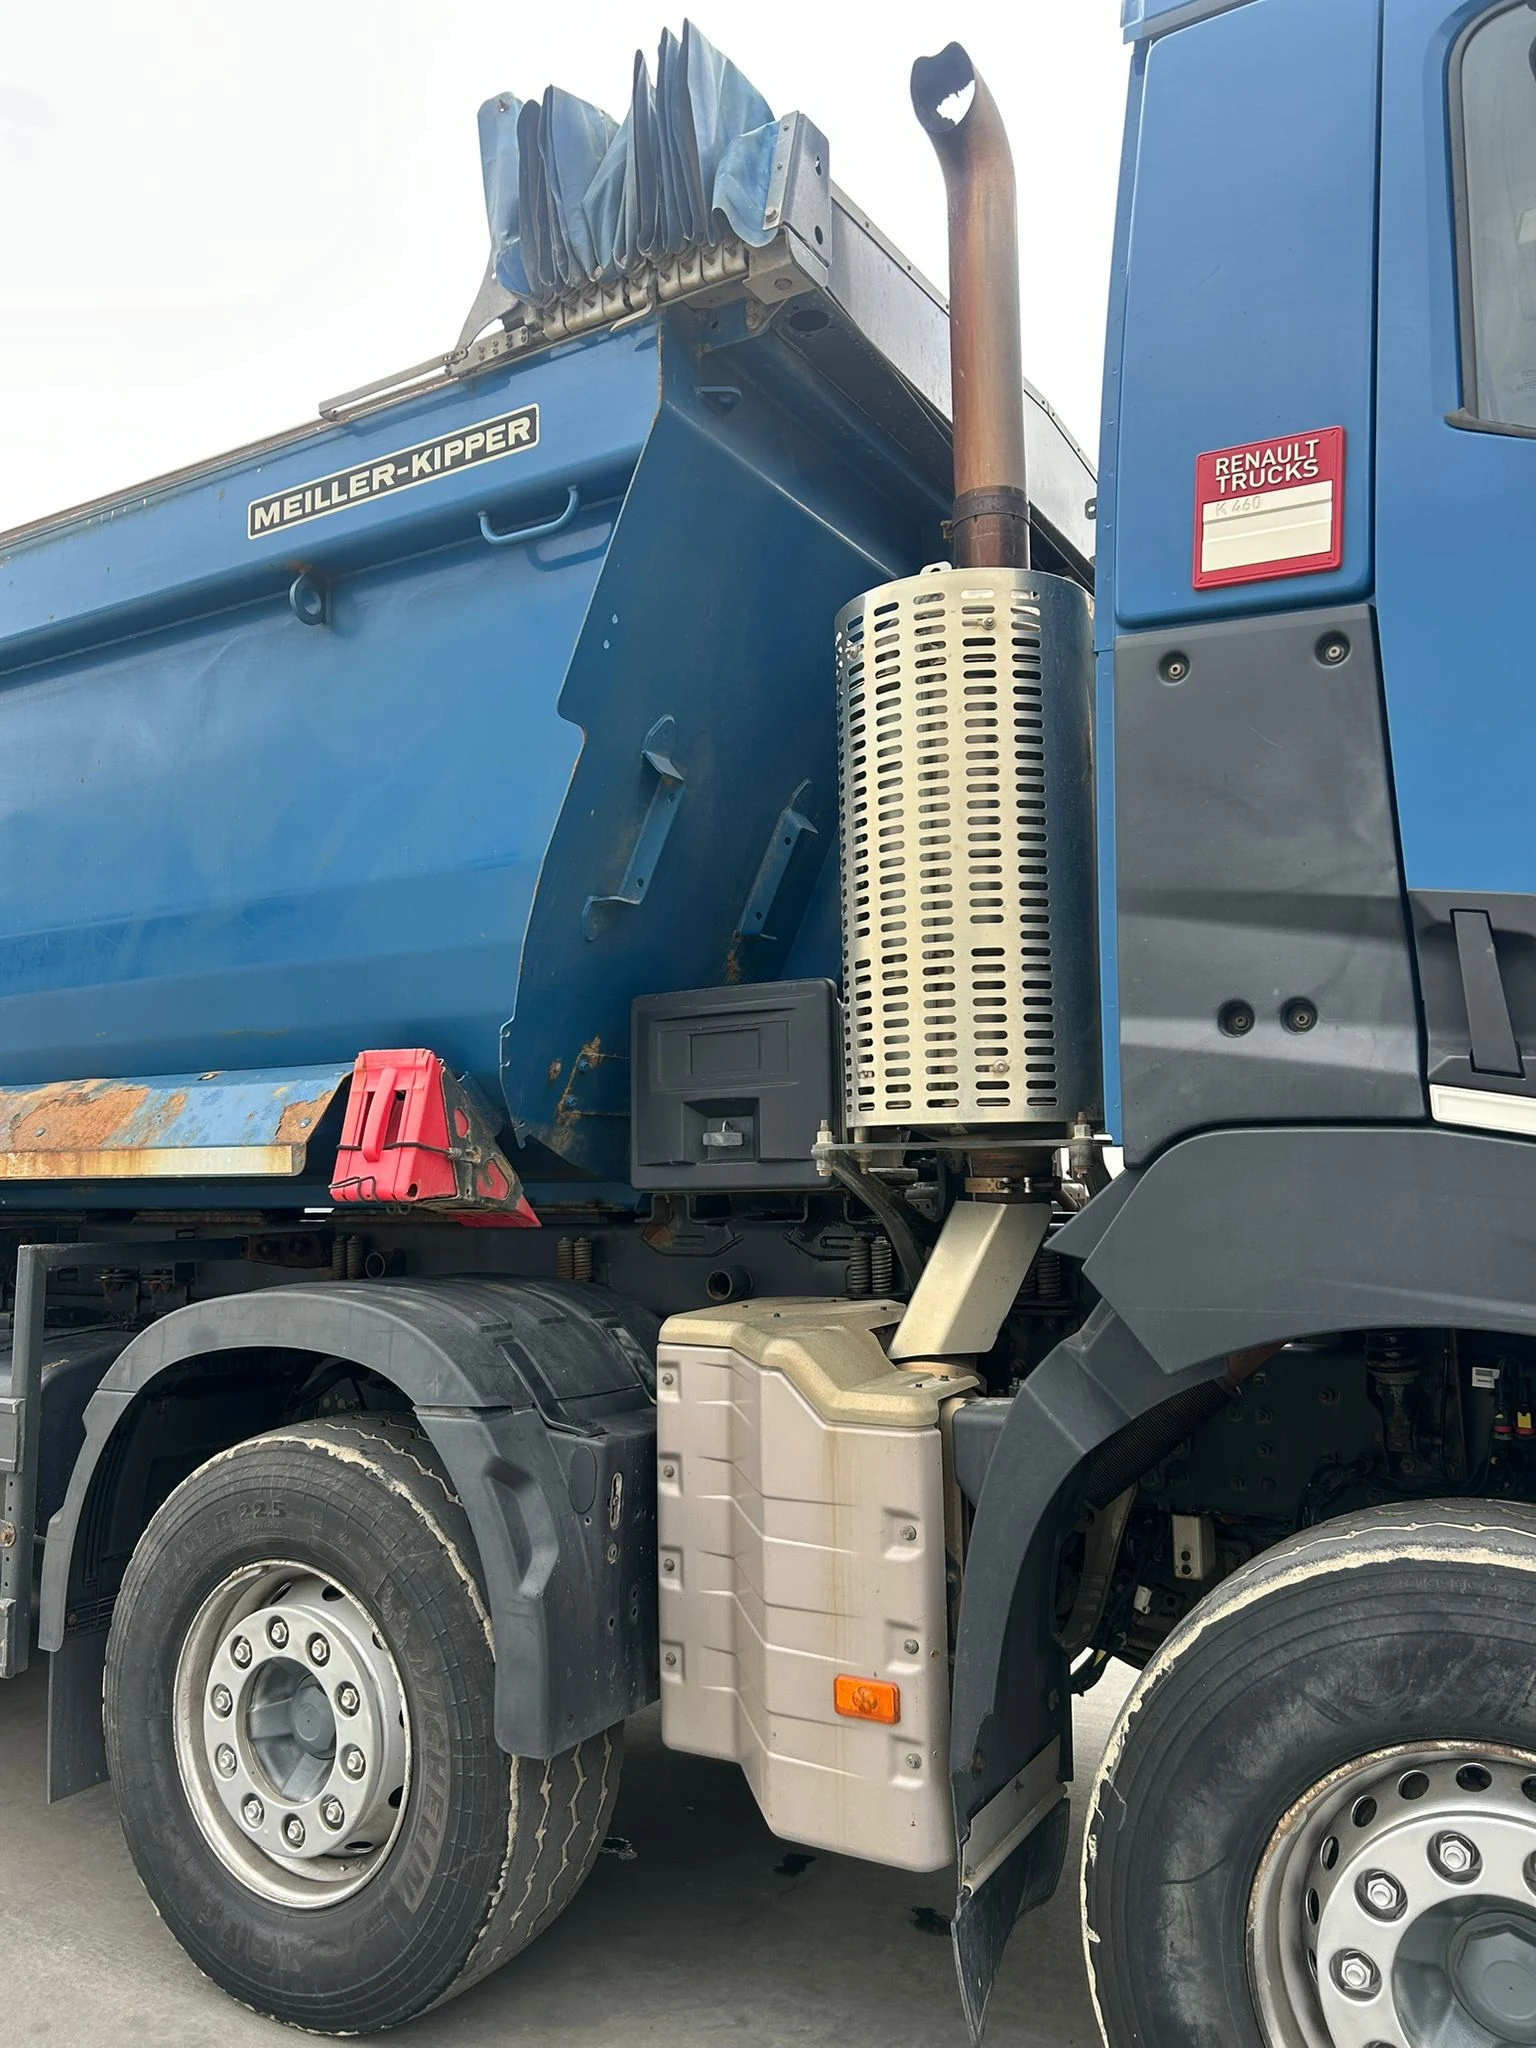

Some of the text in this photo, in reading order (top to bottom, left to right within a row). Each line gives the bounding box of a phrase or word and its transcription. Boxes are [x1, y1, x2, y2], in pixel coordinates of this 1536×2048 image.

[254, 416, 531, 531] MEILLER-KIPPER
[1215, 438, 1320, 477] RENAULT
[1215, 459, 1319, 495] TRUCKS
[1215, 496, 1262, 518] K 460
